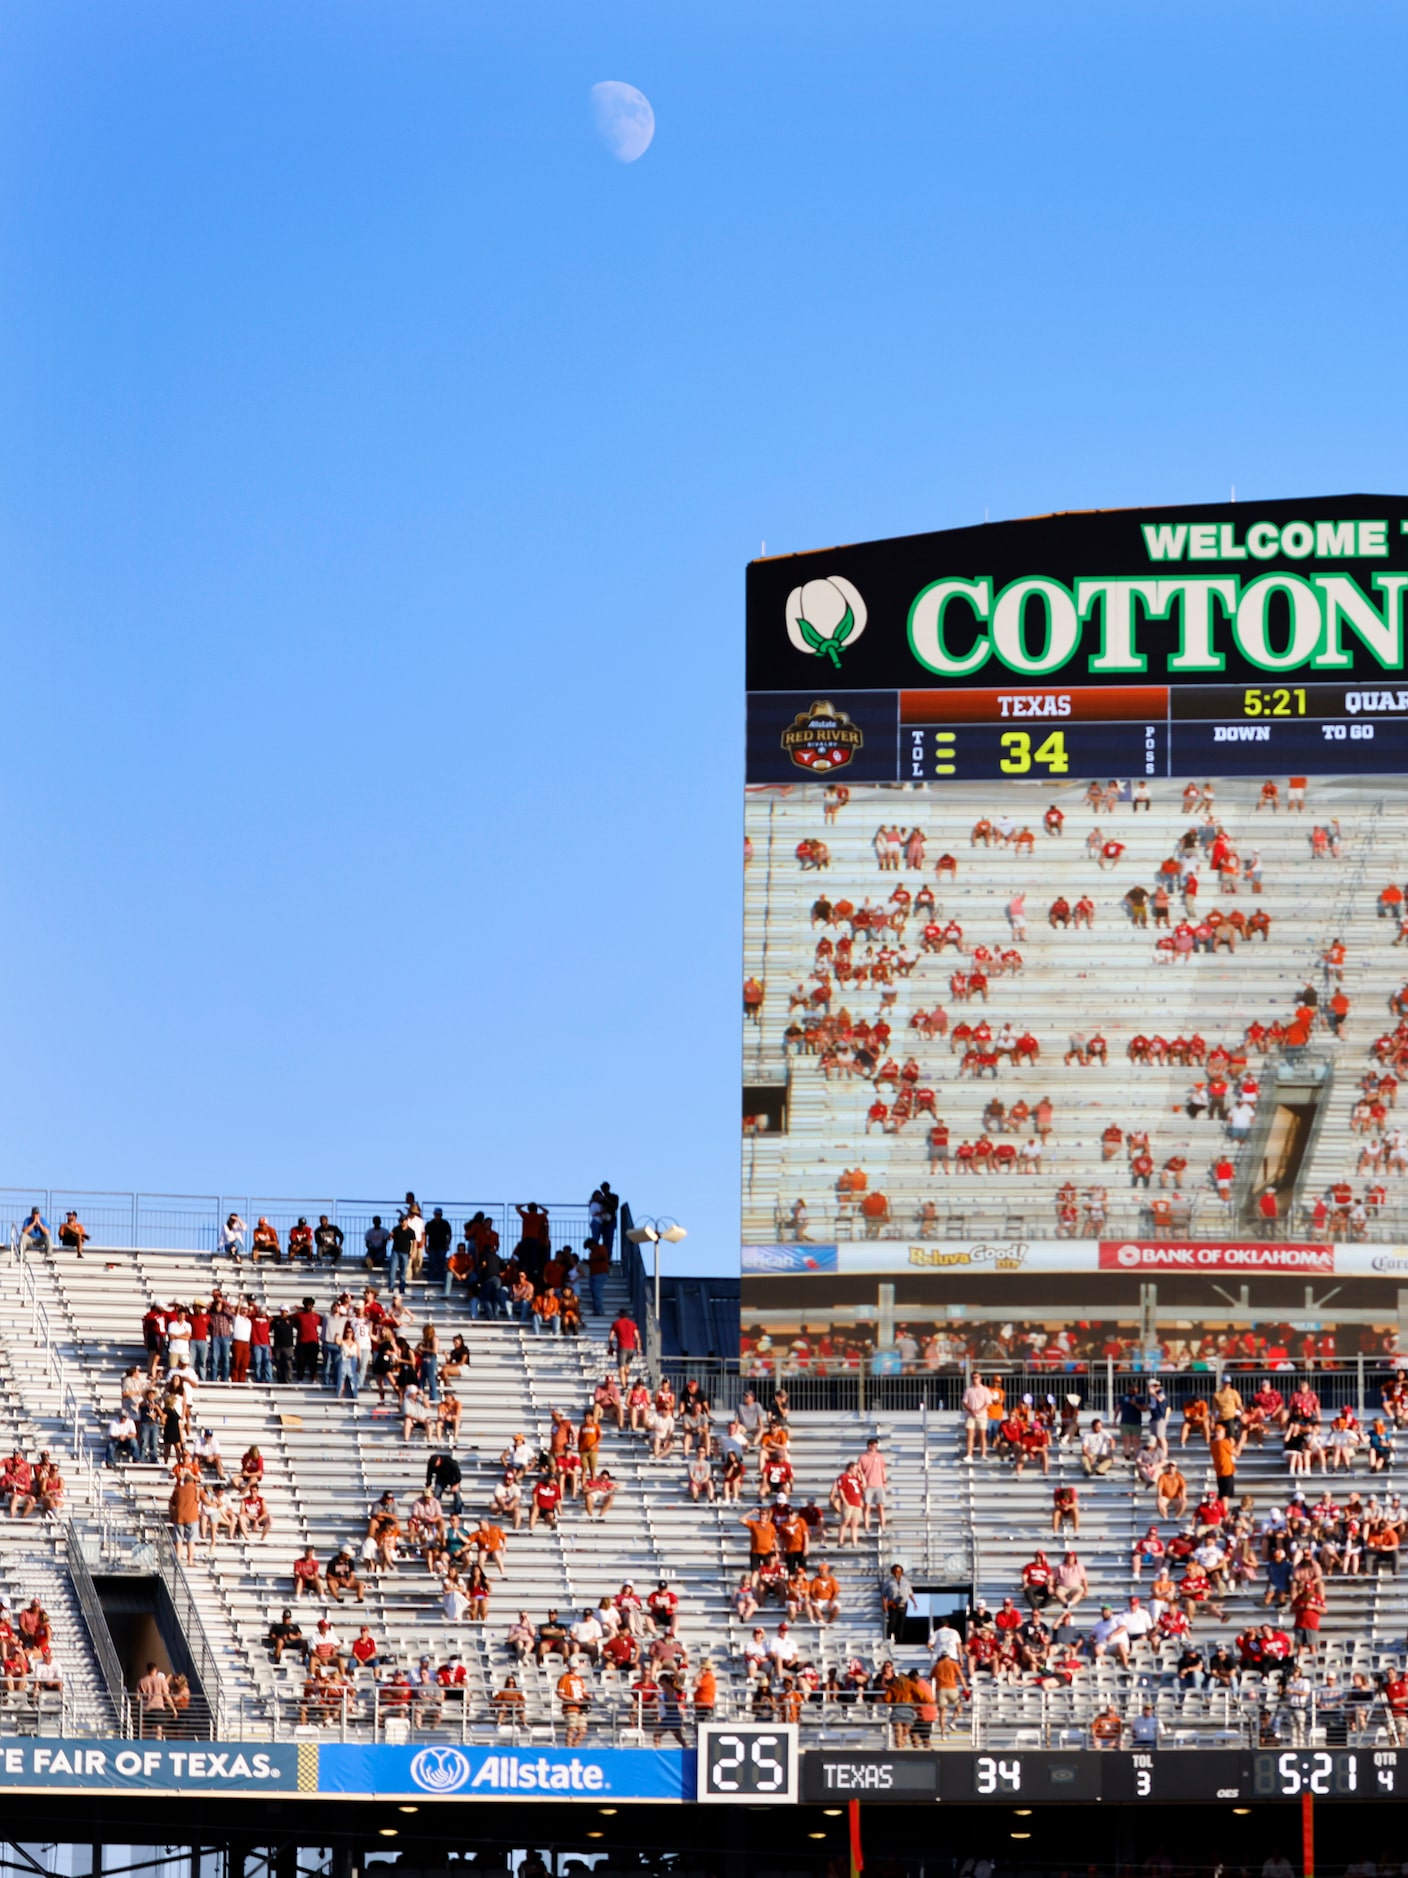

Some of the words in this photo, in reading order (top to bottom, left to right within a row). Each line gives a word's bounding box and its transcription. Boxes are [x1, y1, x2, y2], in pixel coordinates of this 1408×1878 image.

[1141, 519, 1388, 561] WELCOME
[997, 695, 1071, 717] TEXAS
[1244, 689, 1306, 716] 5:21
[786, 730, 814, 744] RED
[816, 730, 859, 743] RIVER
[1213, 726, 1271, 741] DOWN
[1322, 725, 1347, 740] TO
[1350, 724, 1374, 739] GO
[999, 731, 1069, 773] 34
[1143, 1249, 1195, 1264] BANK
[1197, 1249, 1221, 1264] OF
[1224, 1249, 1333, 1266] OKLAHOMA
[34, 1749, 106, 1775] FAIR
[115, 1751, 160, 1776] OF
[713, 1735, 784, 1791] 25
[1132, 1754, 1154, 1769] TOL
[1374, 1751, 1397, 1767] QTR
[471, 1755, 604, 1790] Allstate
[823, 1764, 894, 1789] TEXAS
[977, 1757, 1021, 1794] 34
[1136, 1770, 1151, 1796] 3
[1278, 1752, 1357, 1795] 5:21
[1377, 1770, 1394, 1792] 4
